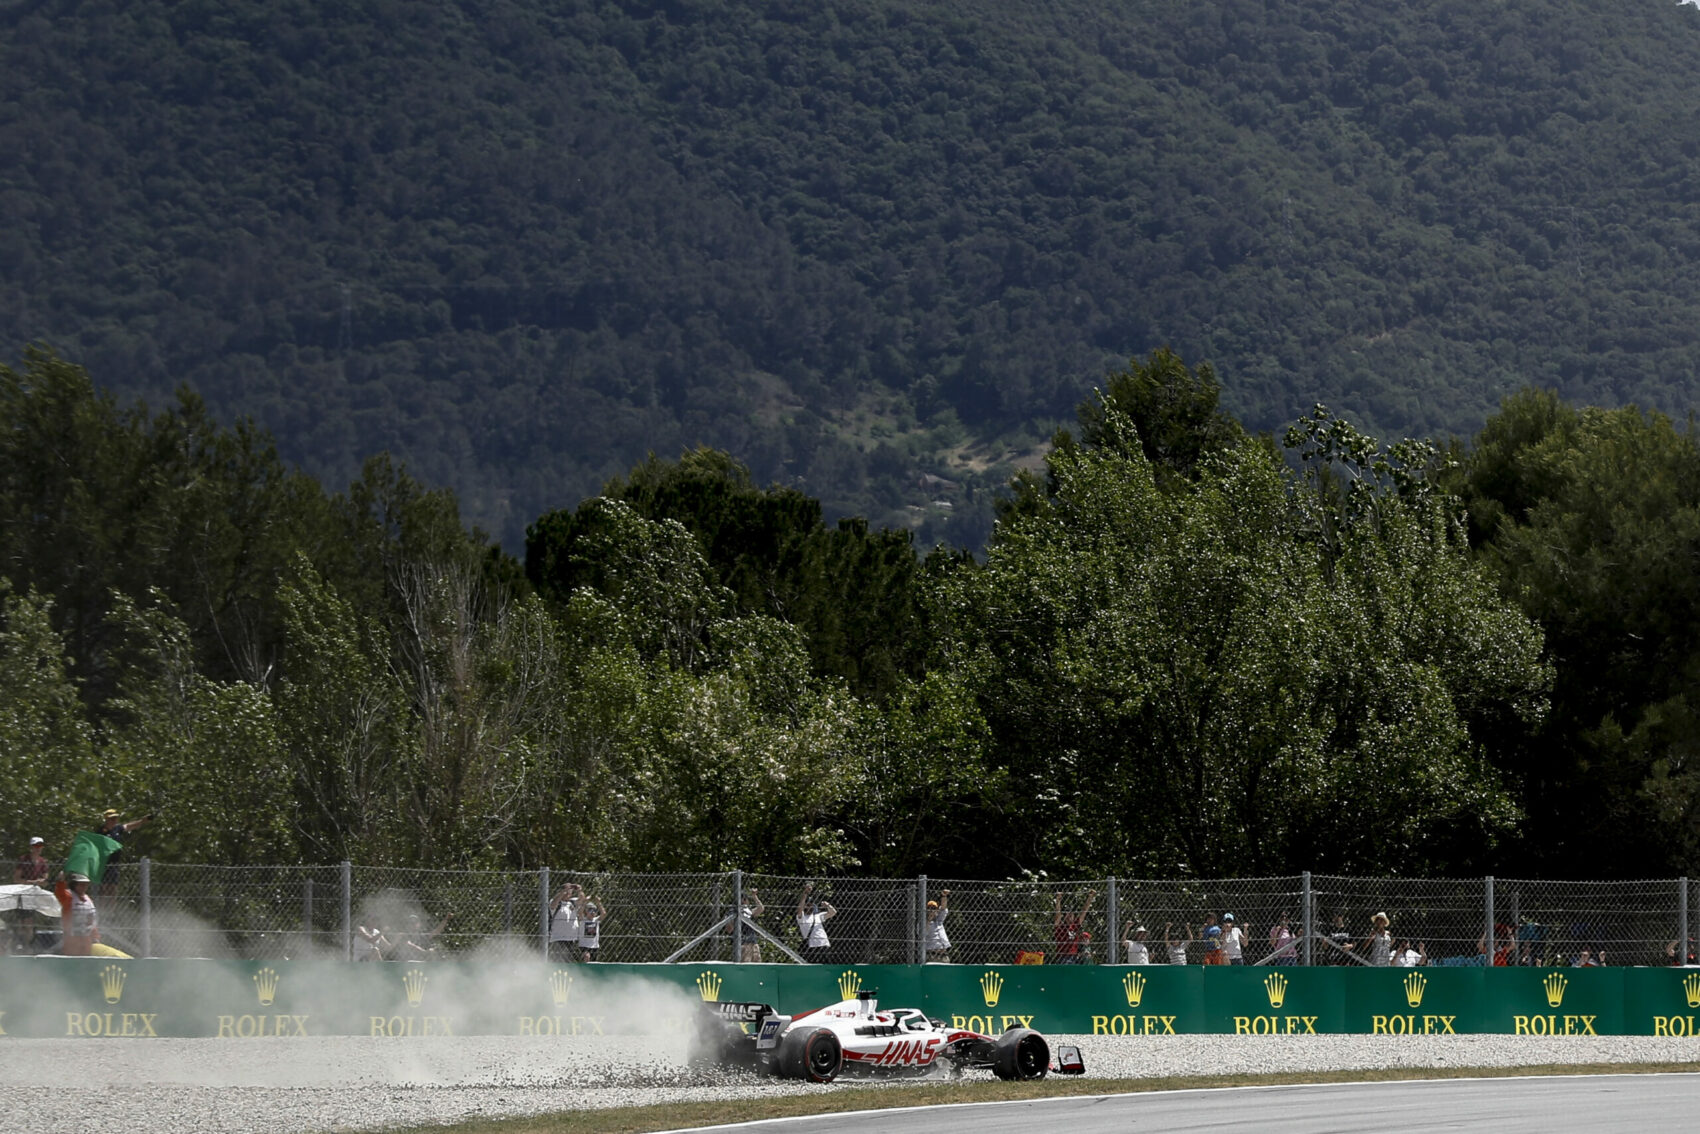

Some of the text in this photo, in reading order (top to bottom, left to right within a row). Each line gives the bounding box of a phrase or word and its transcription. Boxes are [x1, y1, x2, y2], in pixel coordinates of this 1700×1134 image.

[720, 1003, 762, 1020] HAAS
[66, 1012, 158, 1036] ROLEX
[217, 1015, 309, 1037] ROLEX
[369, 1016, 463, 1037] ROLEX
[519, 1015, 606, 1036] ROLEX
[952, 1015, 1035, 1036] ROLEX
[1091, 1015, 1177, 1036] ROLEX
[1233, 1015, 1319, 1036] ROLEX
[1372, 1015, 1457, 1036] ROLEX
[1513, 1015, 1598, 1037] ROLEX
[1653, 1015, 1700, 1038] ROL
[863, 1038, 942, 1067] HAAS
